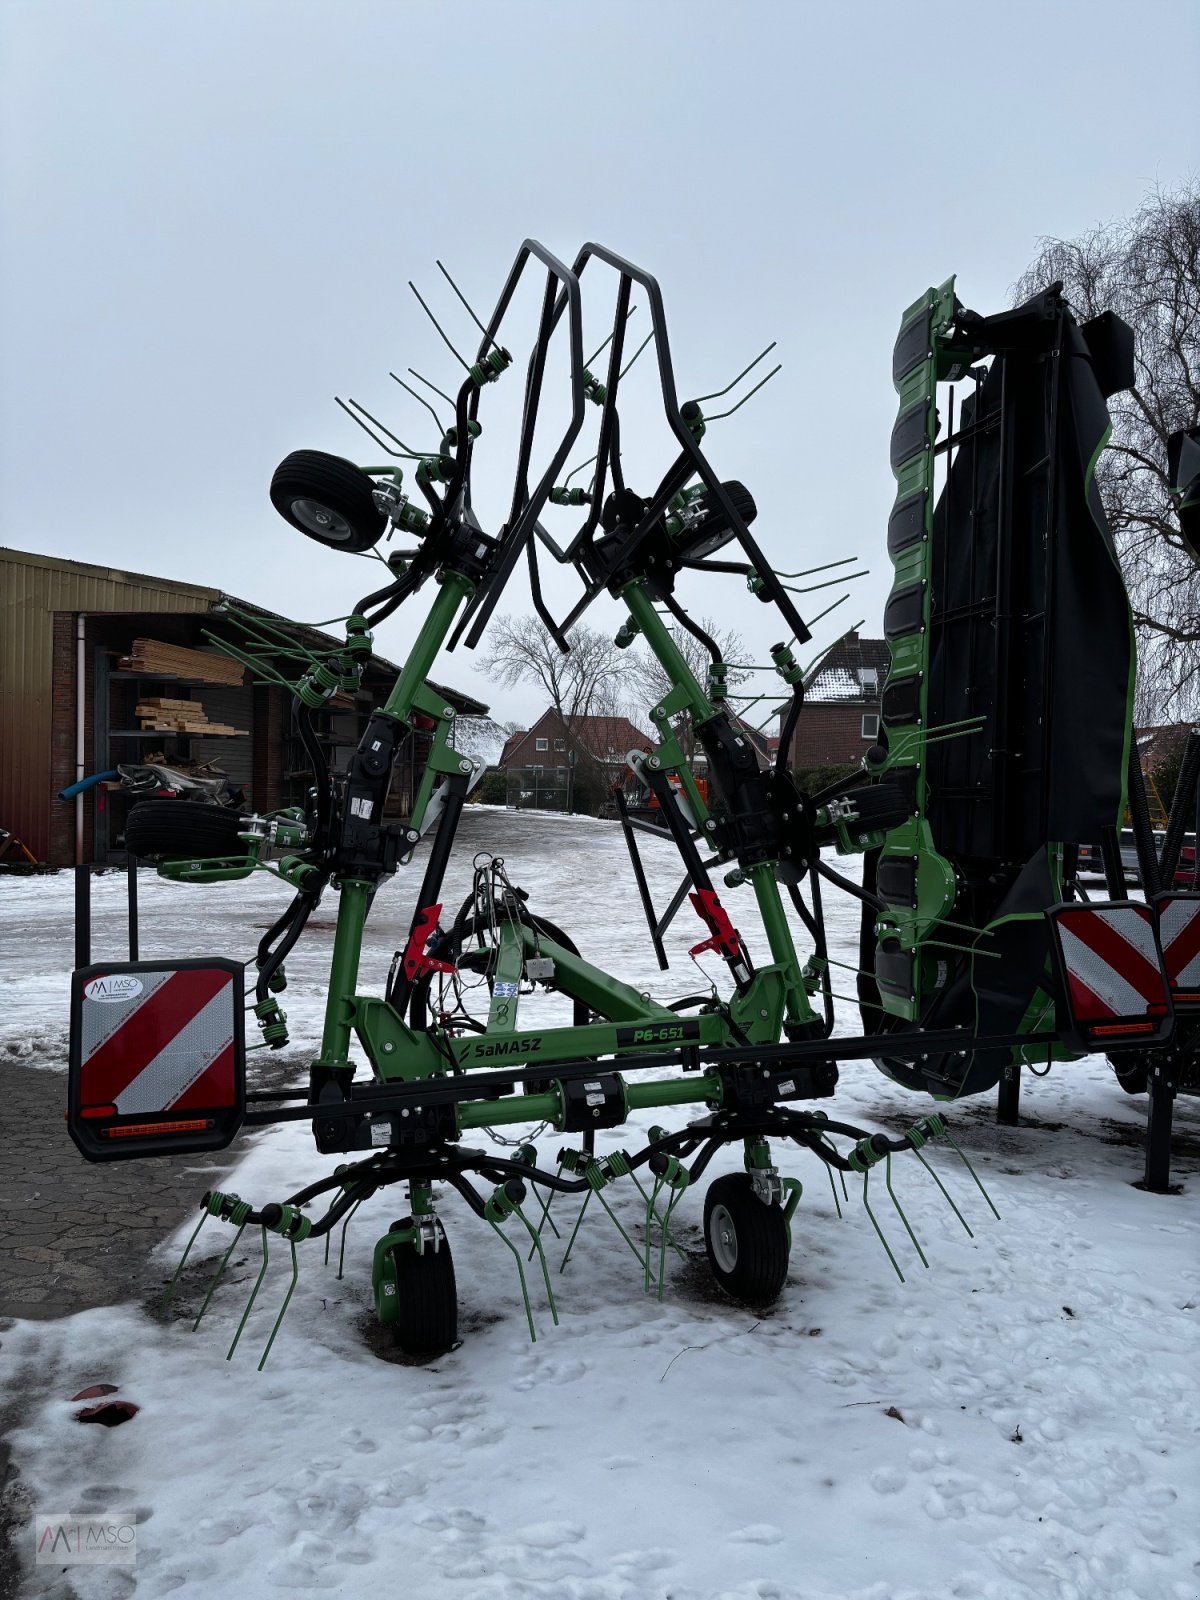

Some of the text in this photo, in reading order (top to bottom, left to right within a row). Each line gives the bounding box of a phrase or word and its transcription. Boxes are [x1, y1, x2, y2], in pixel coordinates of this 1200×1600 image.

[113, 979, 138, 988] MSO
[633, 1026, 684, 1043] P6-651
[474, 1038, 542, 1058] SaMASZ
